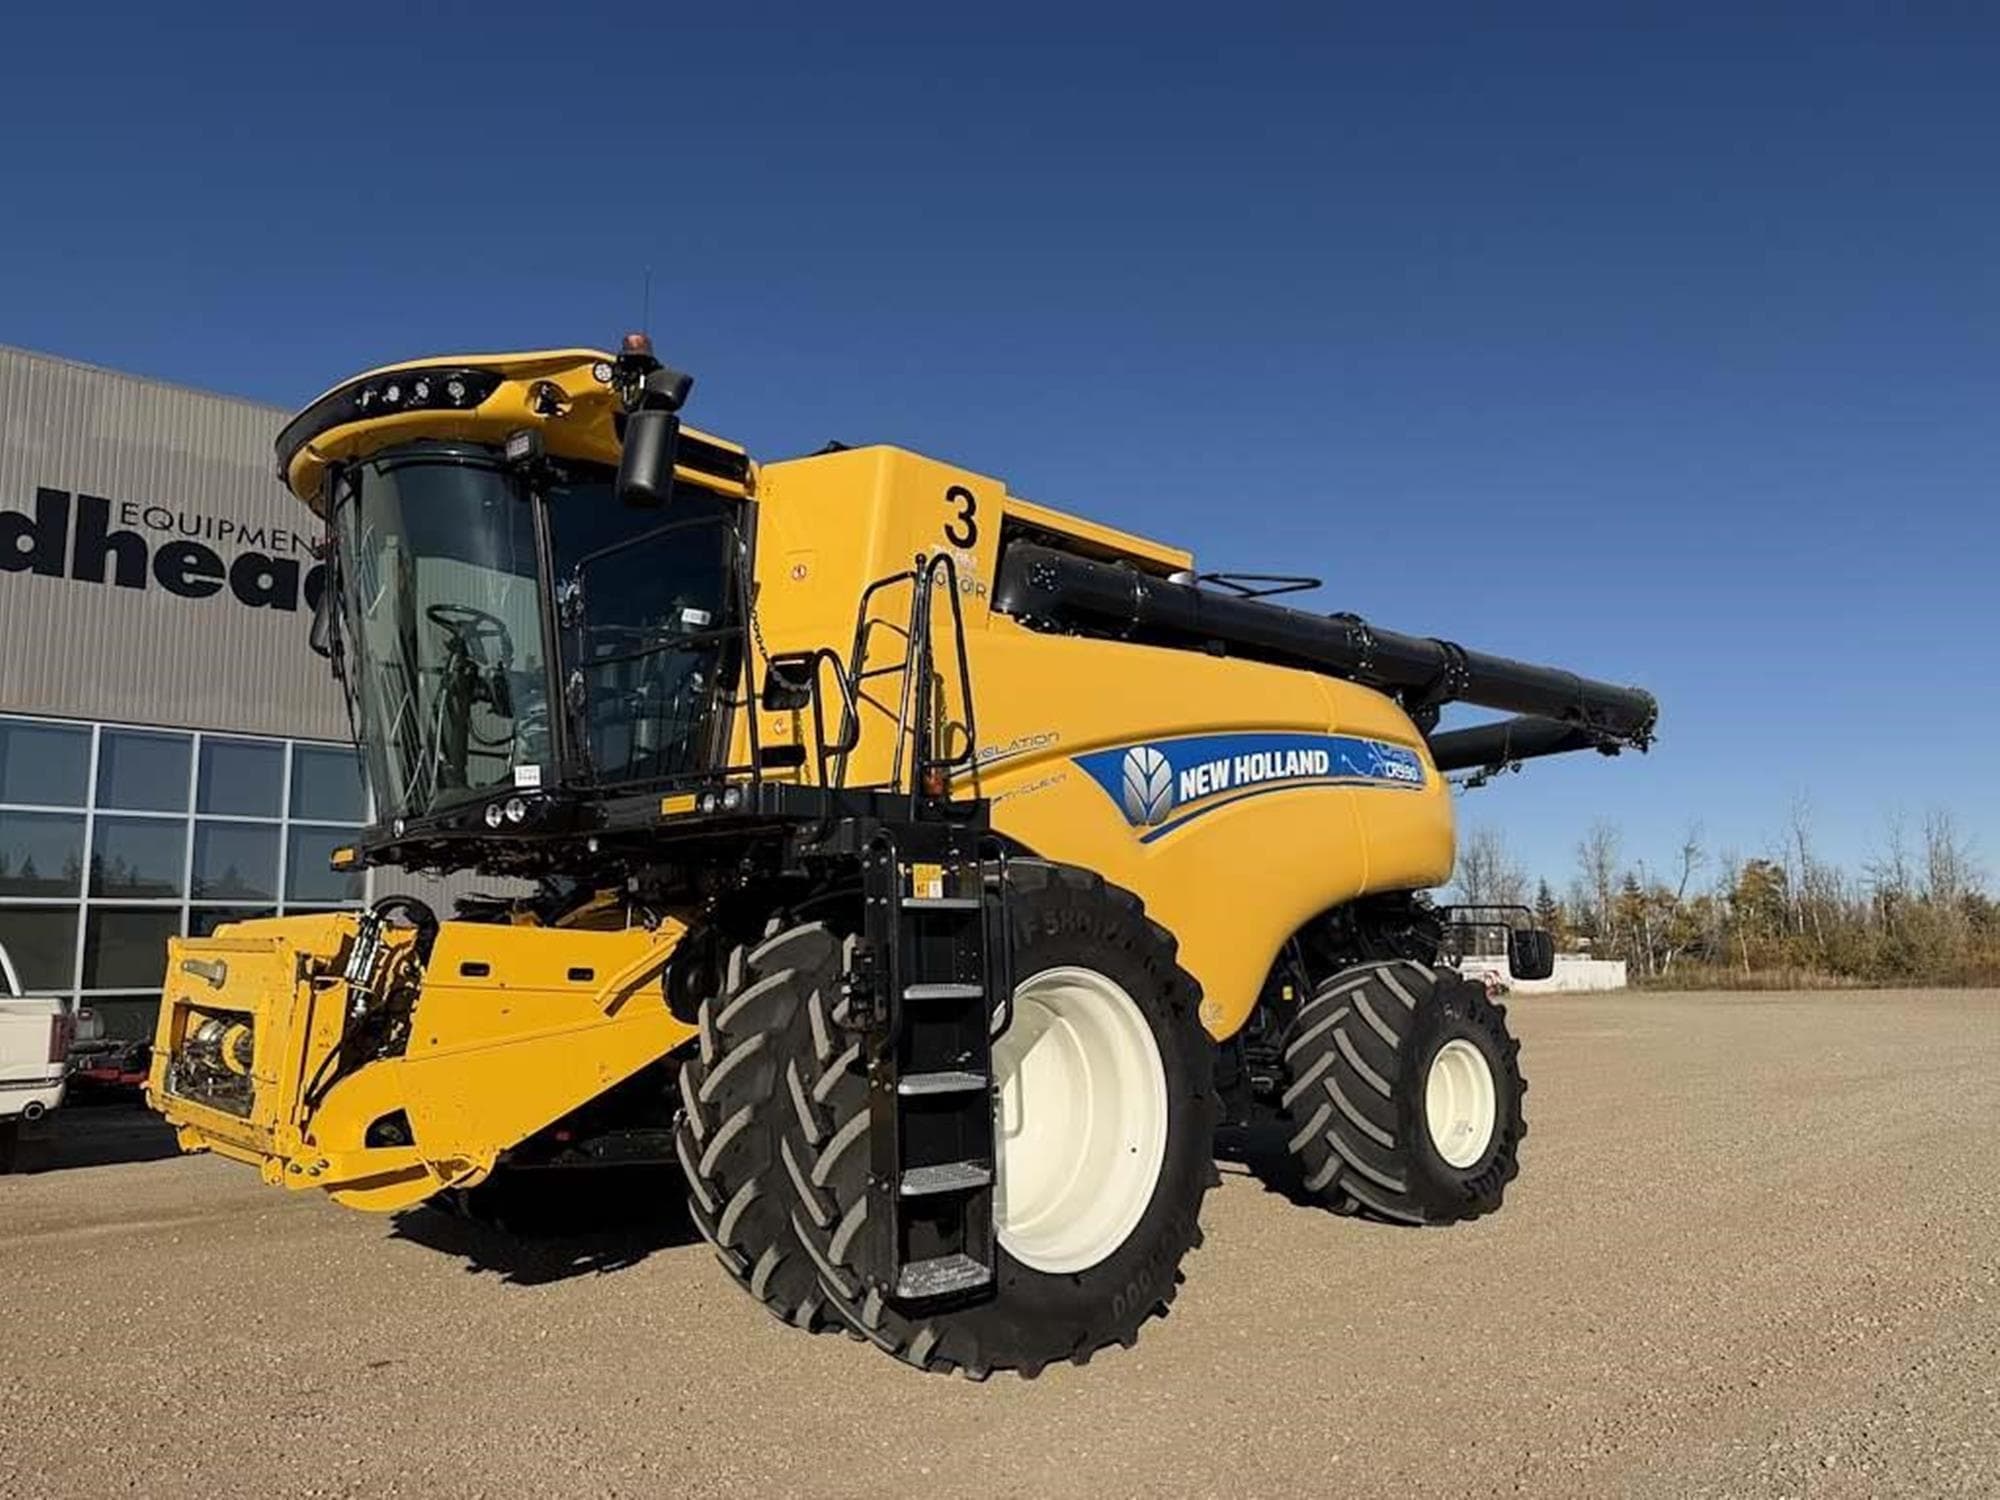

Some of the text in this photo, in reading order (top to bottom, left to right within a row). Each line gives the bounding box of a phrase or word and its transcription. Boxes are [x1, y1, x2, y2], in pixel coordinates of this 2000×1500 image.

[120, 501, 318, 559] EQUIPMEN
[945, 485, 978, 549] 3
[0, 486, 326, 613] dhea
[1179, 749, 1330, 802] NEW HOLLAND
